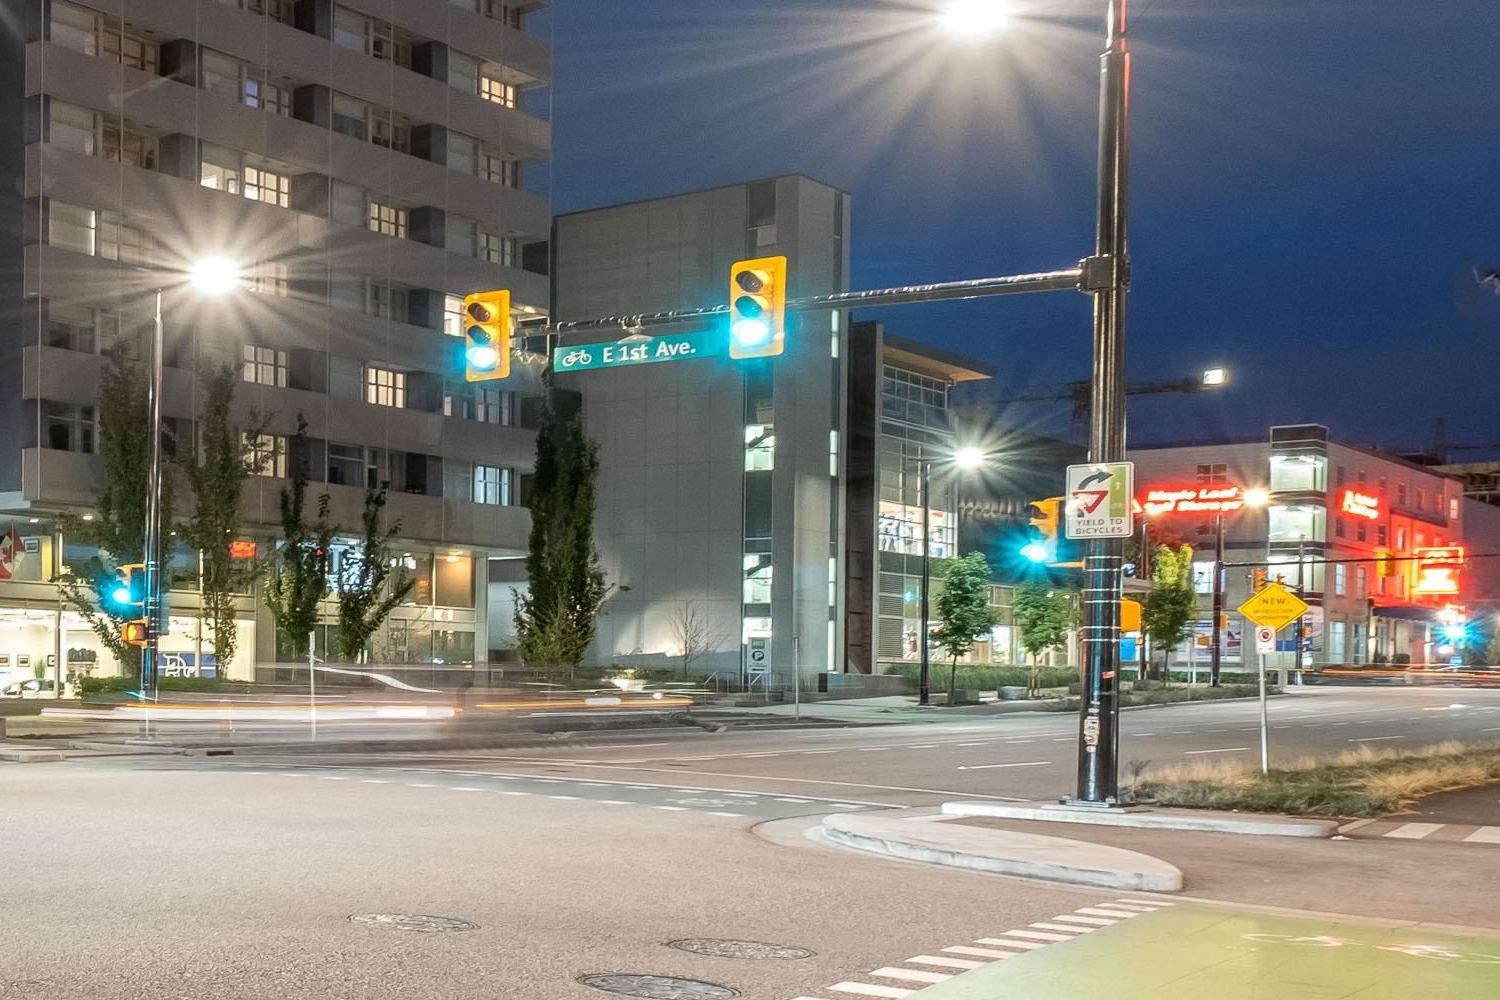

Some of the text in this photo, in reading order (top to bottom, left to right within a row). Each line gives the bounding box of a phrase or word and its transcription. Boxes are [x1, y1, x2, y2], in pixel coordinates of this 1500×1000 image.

[603, 340, 697, 363] E 1st Ave.
[1076, 519, 1105, 527] YIELD
[1075, 526, 1123, 535] BICYCLES
